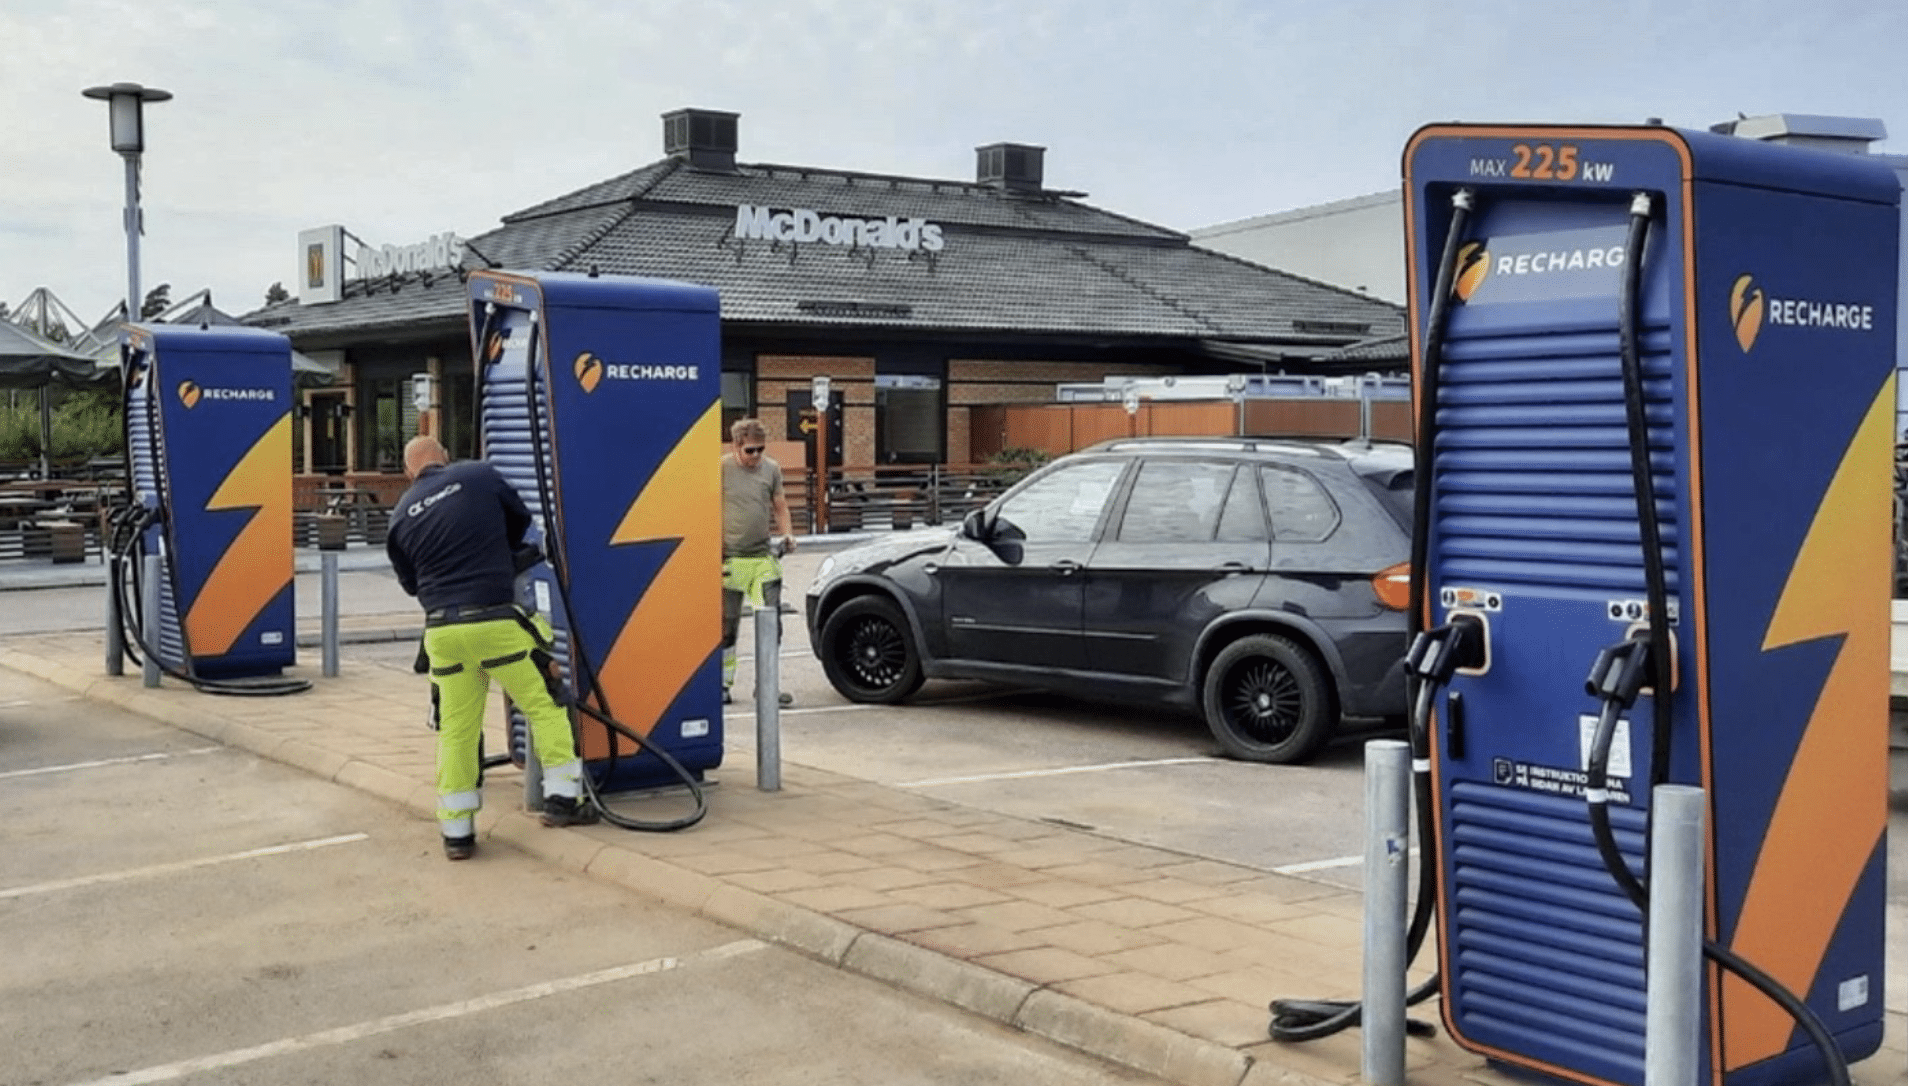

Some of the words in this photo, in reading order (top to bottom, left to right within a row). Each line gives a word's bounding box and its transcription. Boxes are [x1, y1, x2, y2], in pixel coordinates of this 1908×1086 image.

[1470, 158, 1506, 177] MAX
[1510, 145, 1577, 180] 225
[1582, 161, 1613, 182] kW
[735, 204, 944, 250] McDonald's
[356, 231, 465, 279] McDonald's
[1497, 246, 1625, 275] RECHARG
[1768, 299, 1873, 330] RECHARGE
[606, 364, 699, 380] RECHARGE
[203, 388, 275, 401] RECHARGE
